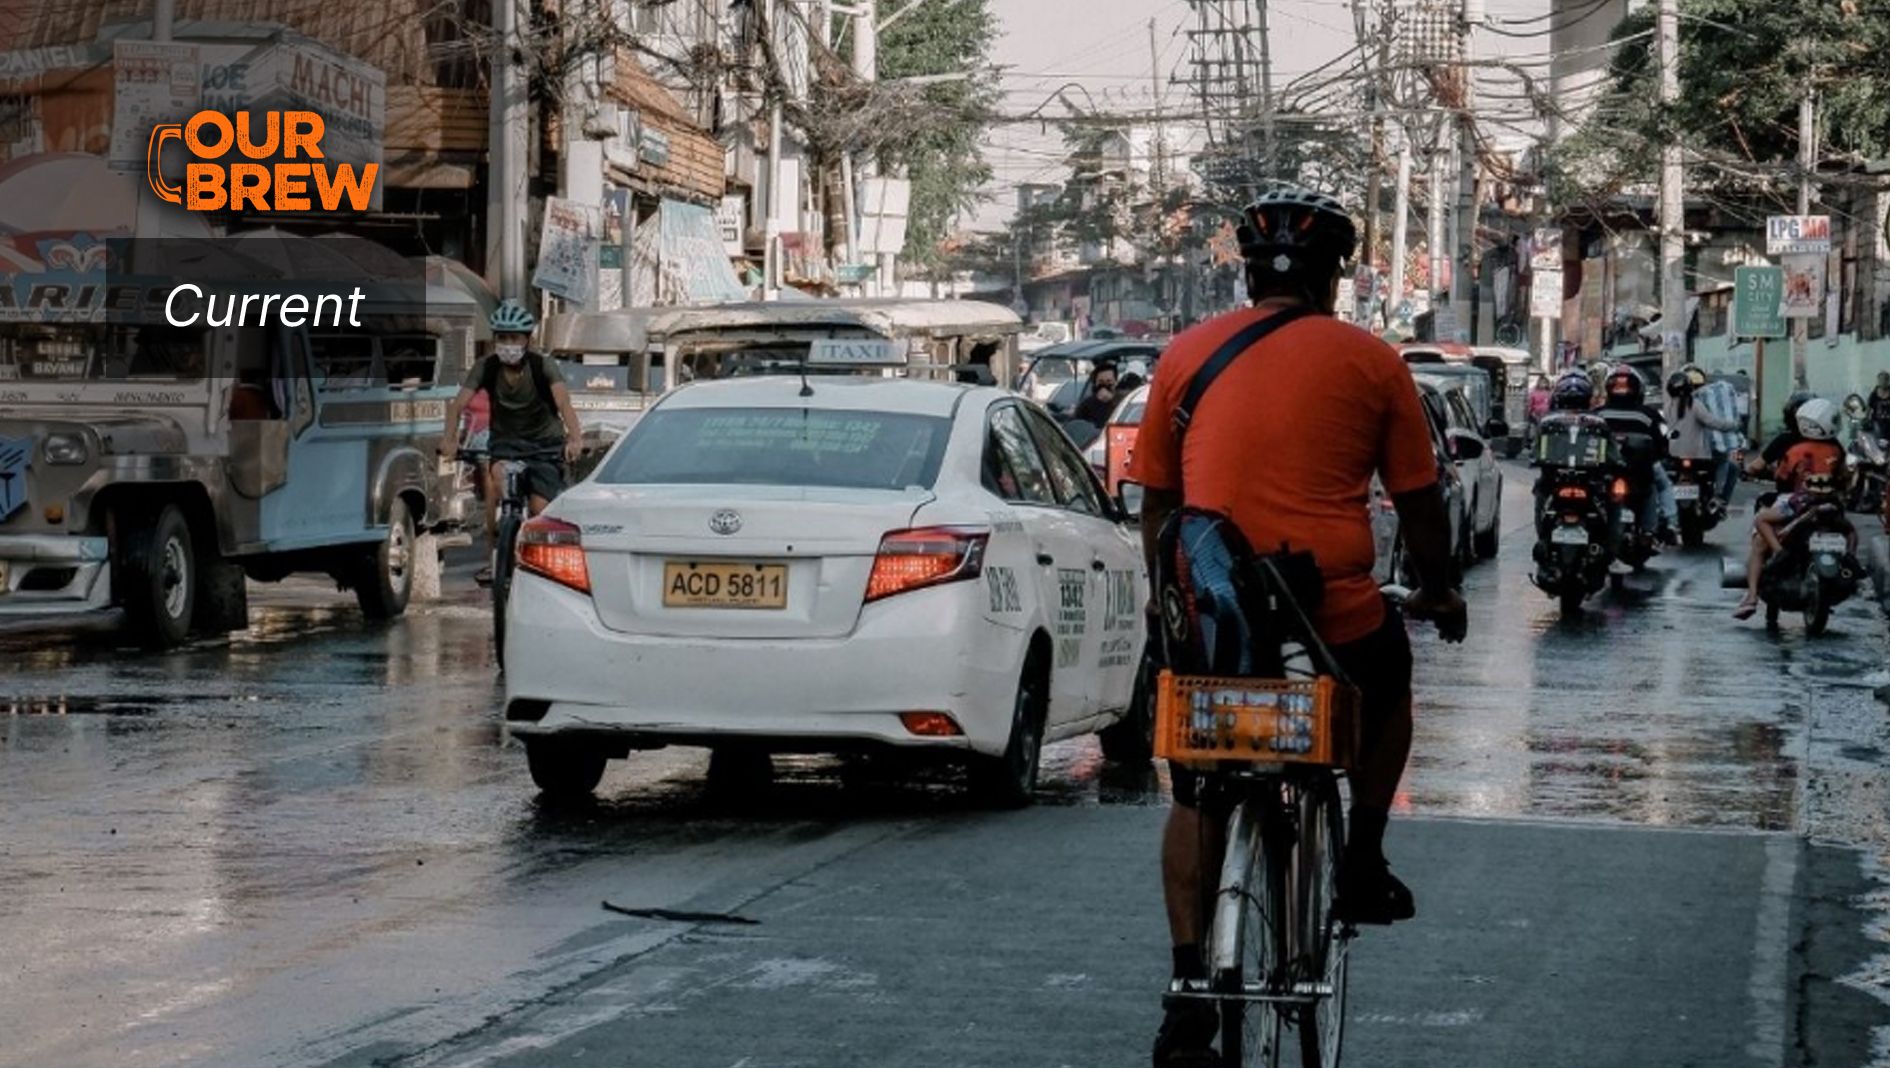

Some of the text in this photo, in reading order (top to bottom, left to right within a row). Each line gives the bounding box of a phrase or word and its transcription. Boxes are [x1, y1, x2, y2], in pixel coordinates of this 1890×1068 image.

[671, 572, 780, 597] ACD 5811
[1060, 584, 1084, 608] 1342
